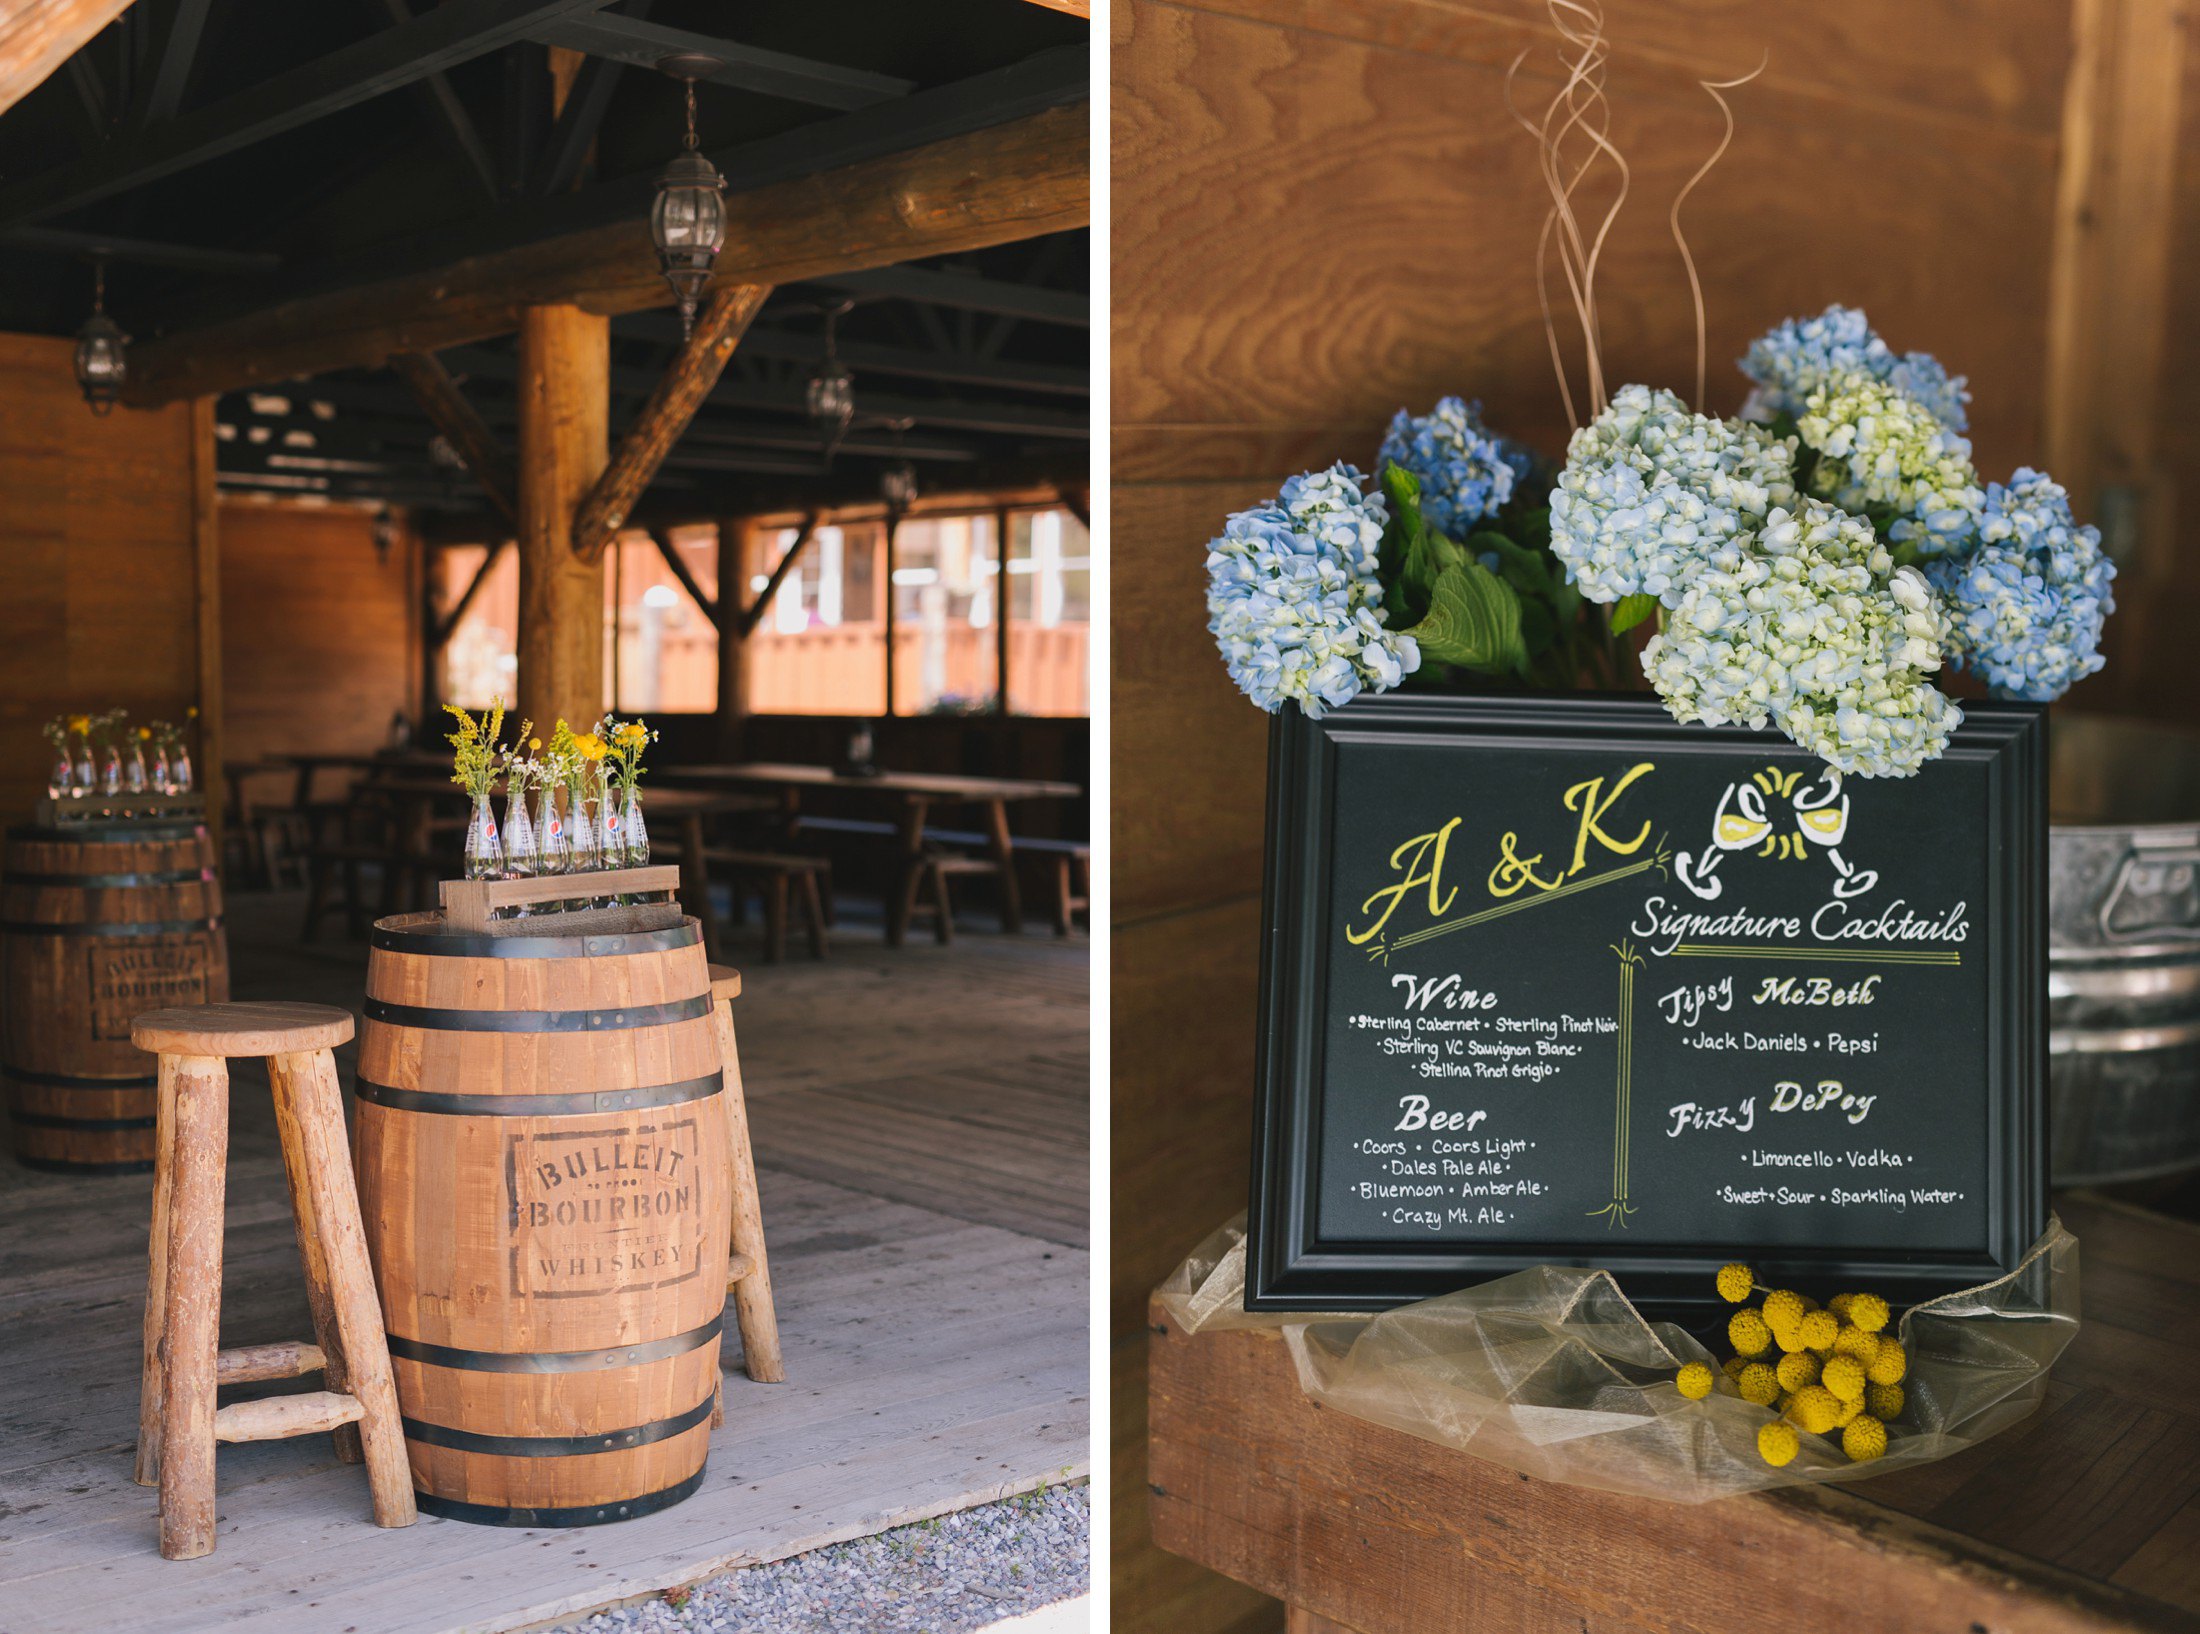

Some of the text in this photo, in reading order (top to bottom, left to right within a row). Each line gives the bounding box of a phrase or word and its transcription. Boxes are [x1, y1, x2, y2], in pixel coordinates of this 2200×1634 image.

[1346, 763, 1655, 944] A & K
[1631, 896, 1970, 956] Signature Cocktails
[1391, 973, 1499, 1012] Wine
[1657, 974, 1882, 1028] Tipsy McBeth
[1357, 1013, 1616, 1041] Sterling Cabernet Sterling Pinot Noir
[1382, 1037, 1577, 1063] Sterling VC Sauvignon Blanc
[1692, 1031, 1879, 1056] Jack Daniels Pepsi
[1418, 1061, 1553, 1083] Stellina Pinot Grigio
[1393, 1094, 1488, 1132] Beer
[1665, 1080, 1878, 1138] Fizzy DePoy
[1362, 1137, 1527, 1161] Coors Coors Light
[1752, 1148, 1903, 1168] Limoncello Vodka
[536, 1143, 684, 1190] BULLEIT
[1390, 1158, 1503, 1176] Dales Pale Ale
[1358, 1179, 1542, 1200] Bluemoon Amber Ale
[1722, 1184, 1769, 1205] Sweet
[1776, 1186, 1816, 1205] Sour
[1830, 1187, 1907, 1213] Sparkling
[1909, 1188, 1958, 1205] Water
[529, 1186, 689, 1227] BOURBON
[1391, 1205, 1506, 1231] Crazy Mt. Ale
[539, 1244, 683, 1276] WHISKEY
